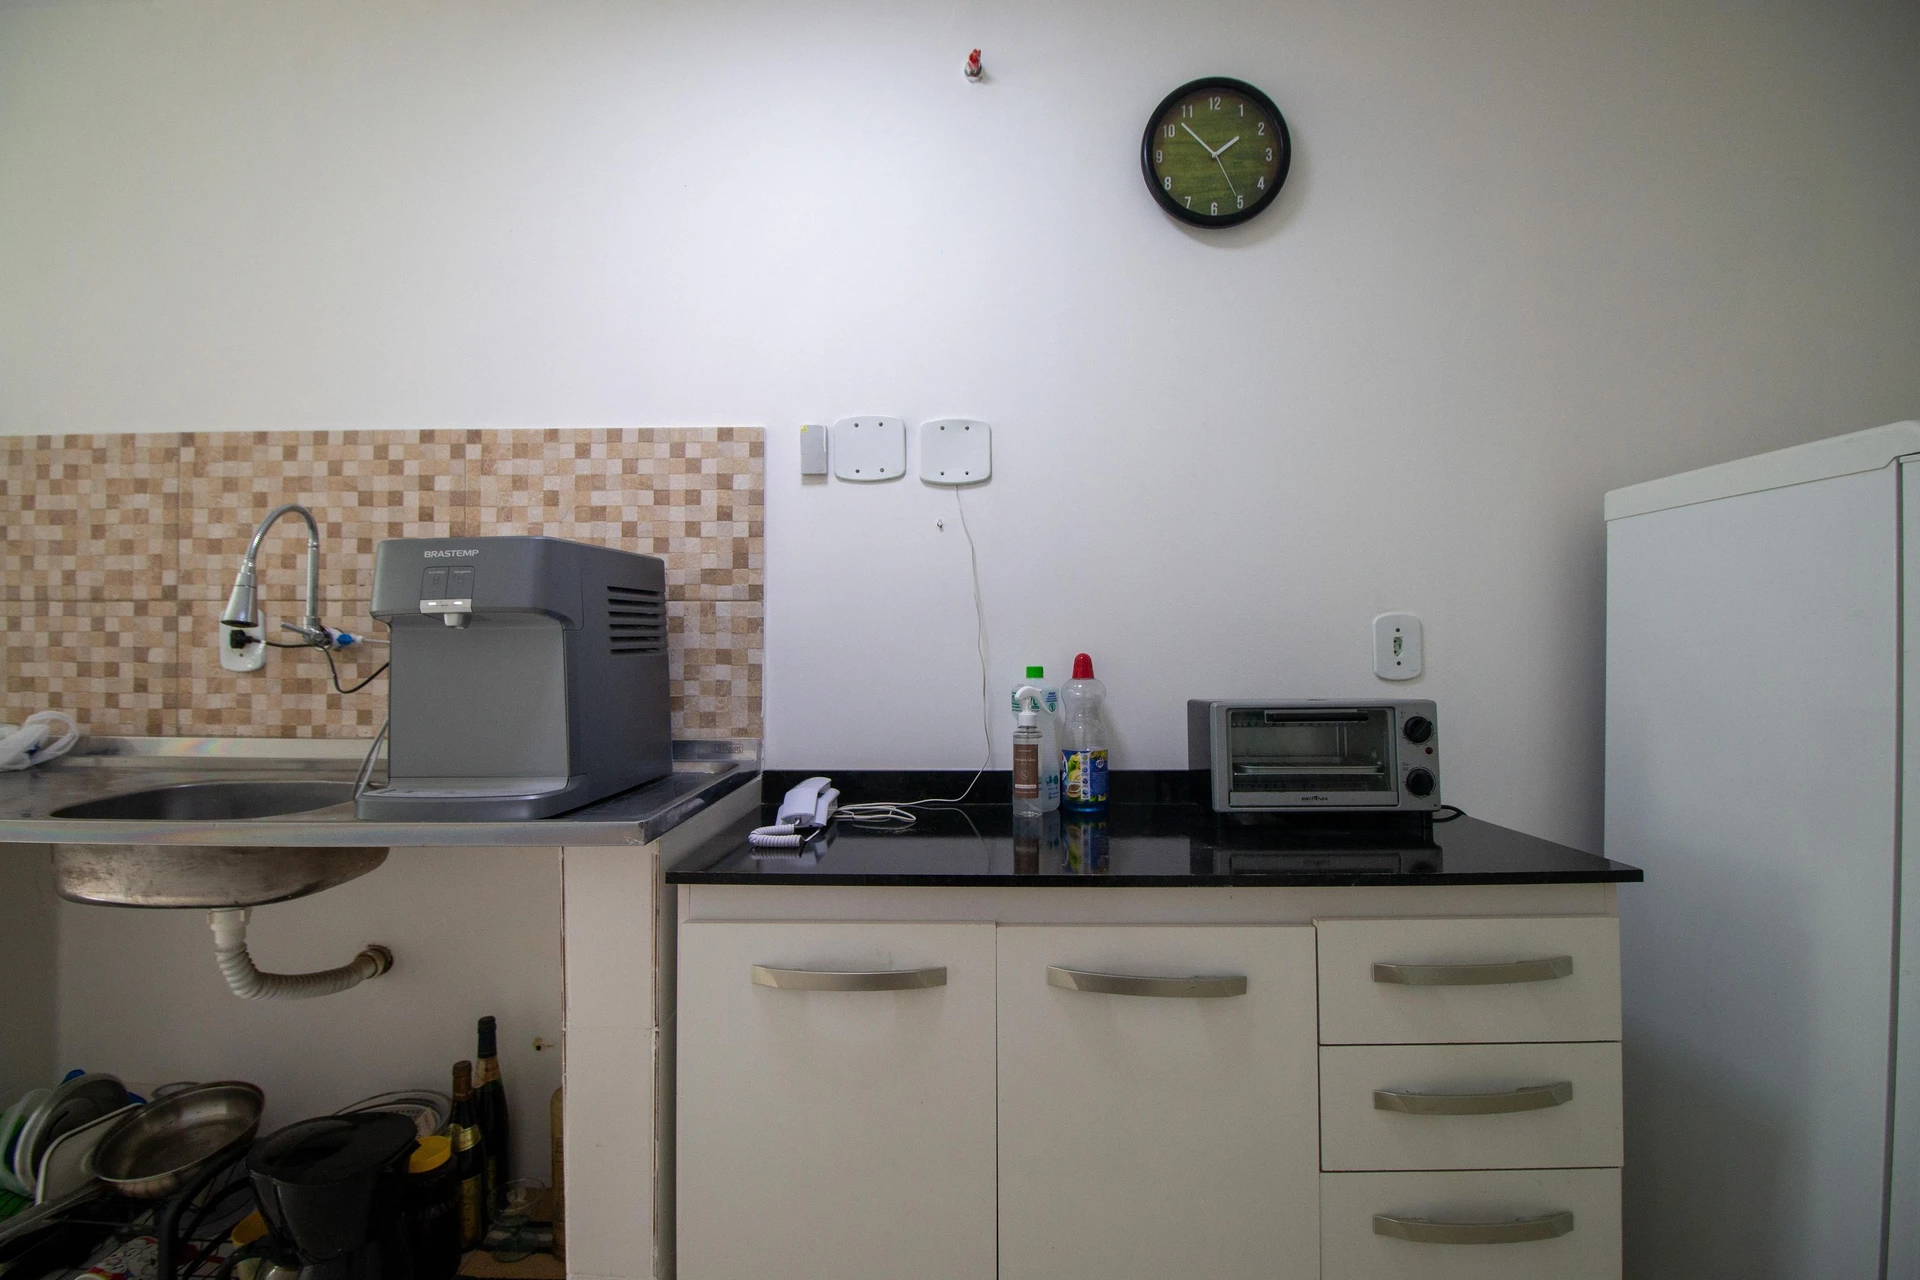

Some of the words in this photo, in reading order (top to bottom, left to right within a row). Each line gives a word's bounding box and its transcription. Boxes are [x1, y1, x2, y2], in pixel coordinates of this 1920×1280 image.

[1208, 96, 1220, 110] 12
[1181, 104, 1192, 118] 11
[1163, 124, 1175, 138] 10
[1258, 122, 1264, 136] 2
[1156, 150, 1162, 164] 9
[1266, 148, 1272, 162] 3
[1164, 176, 1172, 190] 8
[1258, 176, 1264, 190] 4
[1185, 196, 1192, 208] 7
[1211, 202, 1218, 216] 6
[1237, 196, 1244, 208] 5
[424, 549, 479, 558] BRASTEMP
